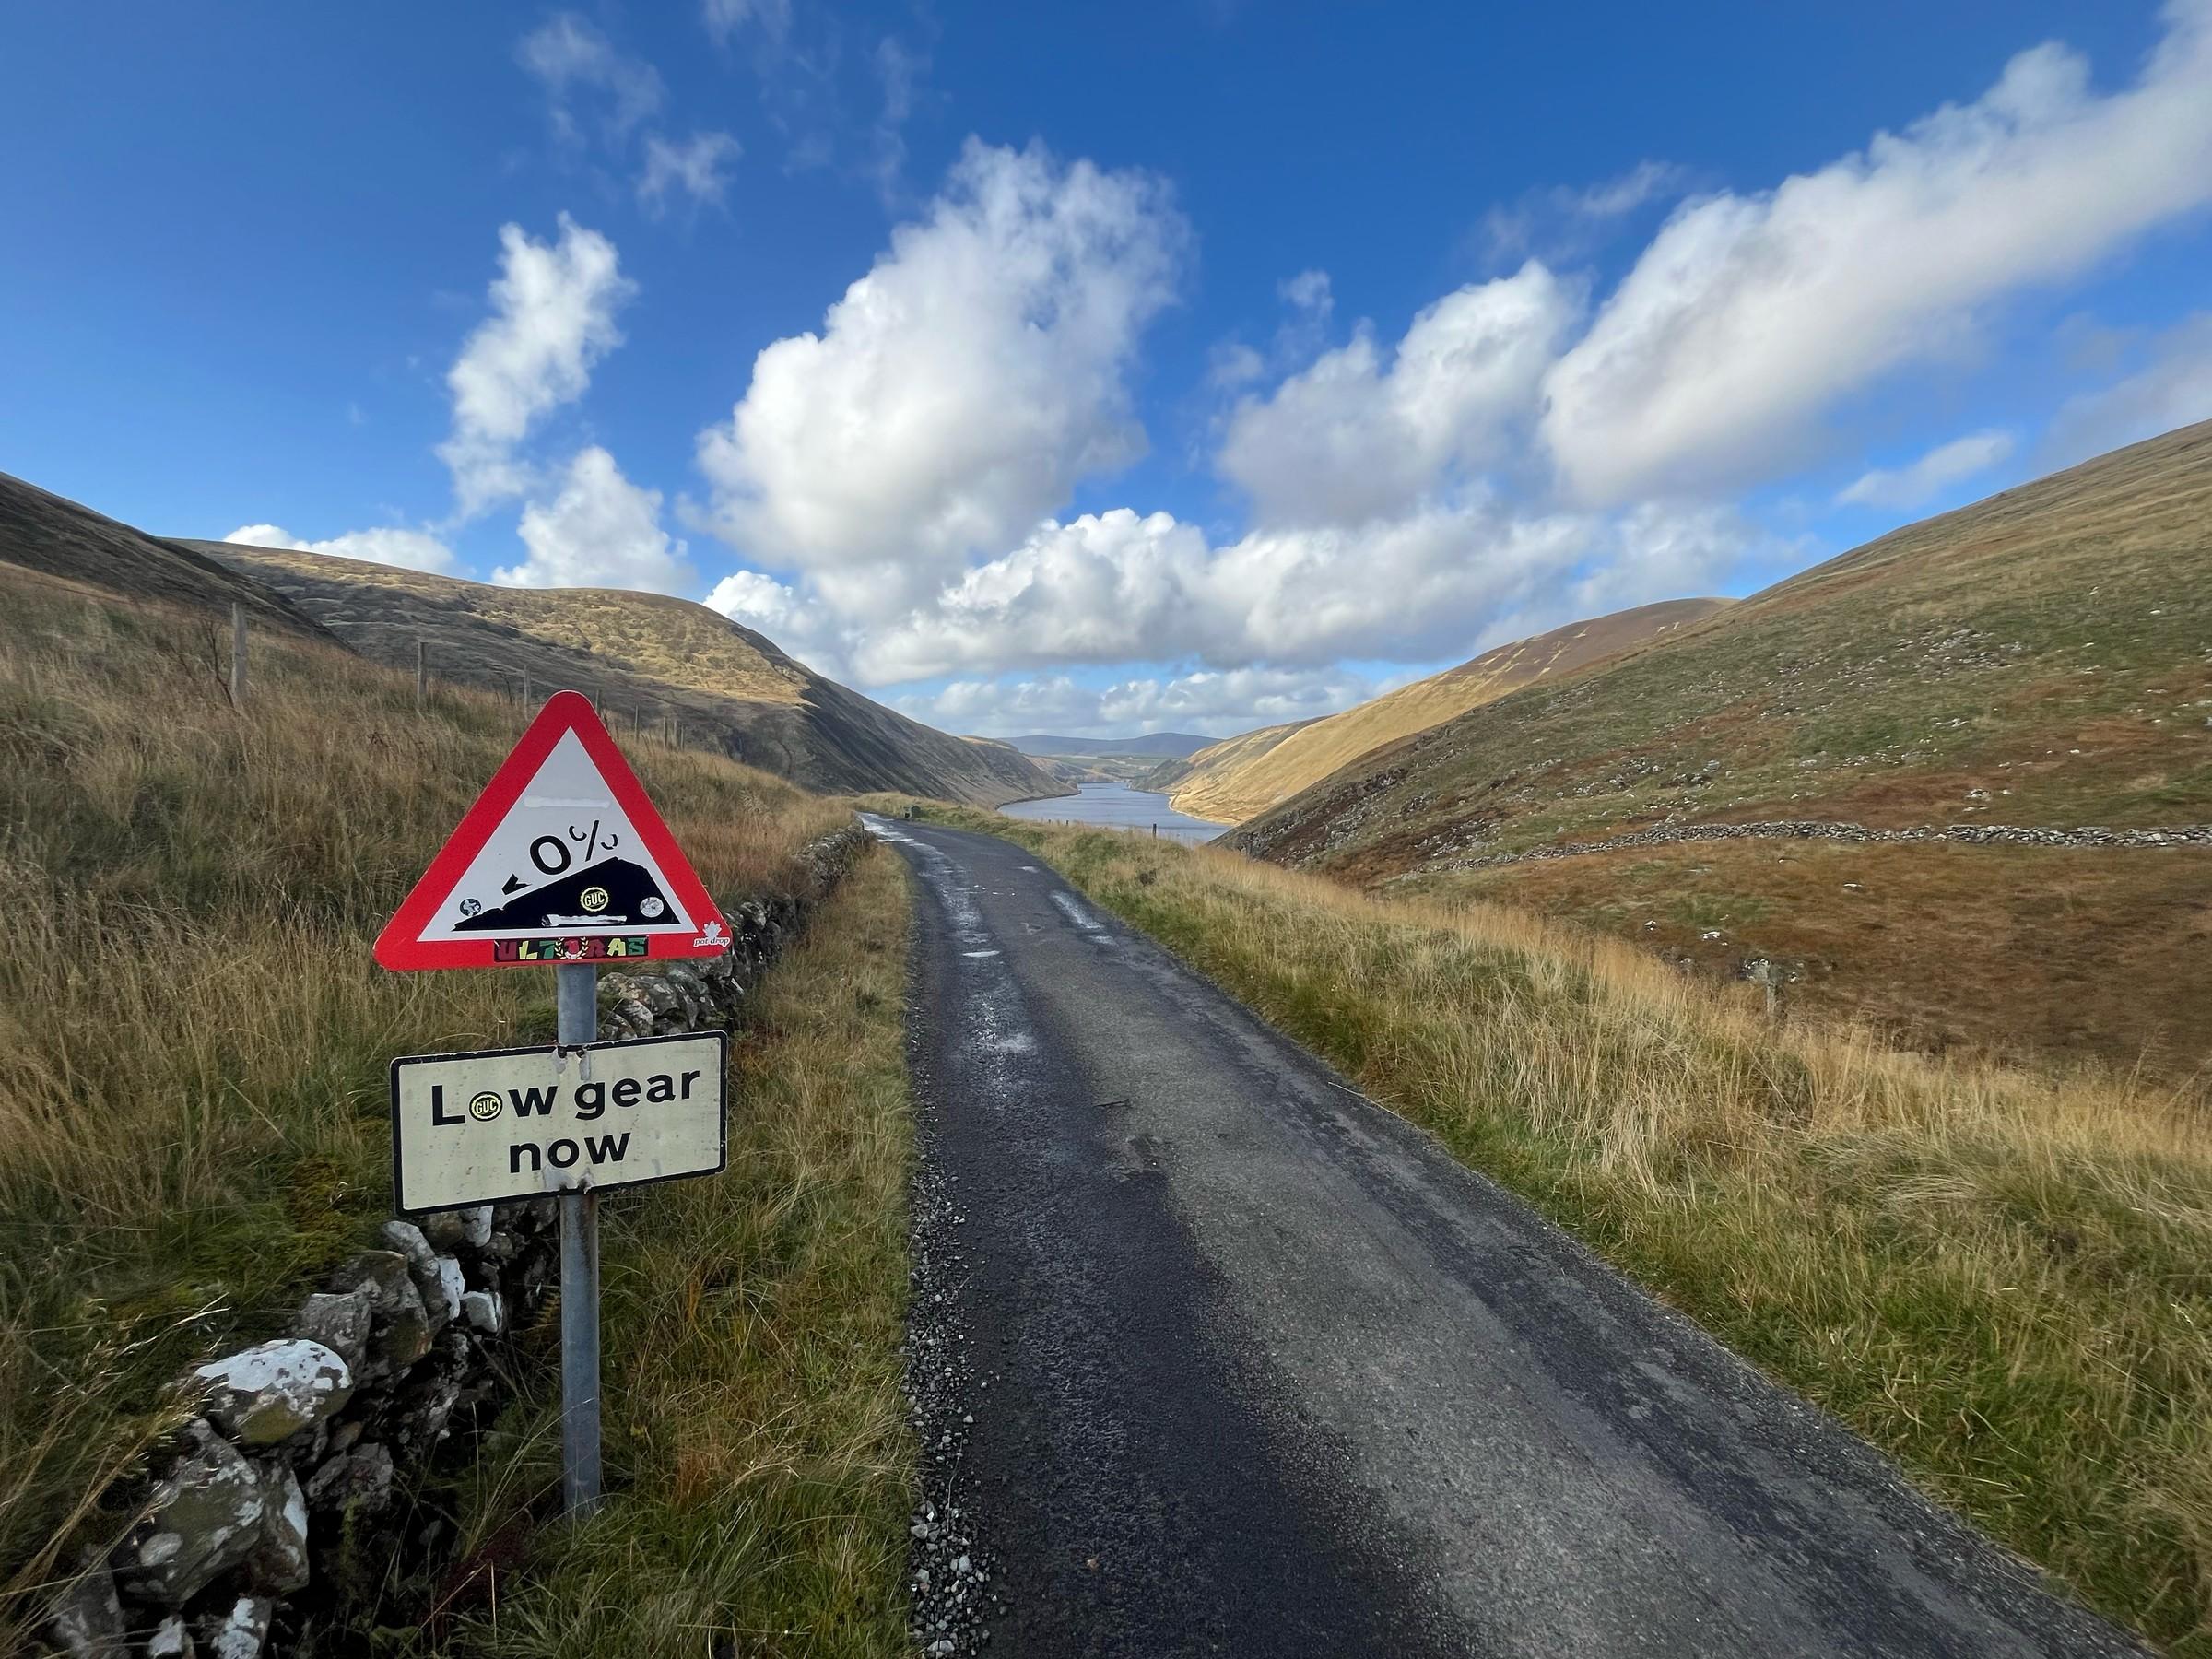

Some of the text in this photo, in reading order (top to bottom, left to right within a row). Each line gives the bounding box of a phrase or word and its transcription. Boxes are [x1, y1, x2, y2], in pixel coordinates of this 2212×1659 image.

[584, 890, 605, 907] GUC
[710, 936, 729, 947] drop
[431, 1070, 700, 1126] Lw gear
[476, 1099, 498, 1114] GUC
[509, 1132, 631, 1173] now
